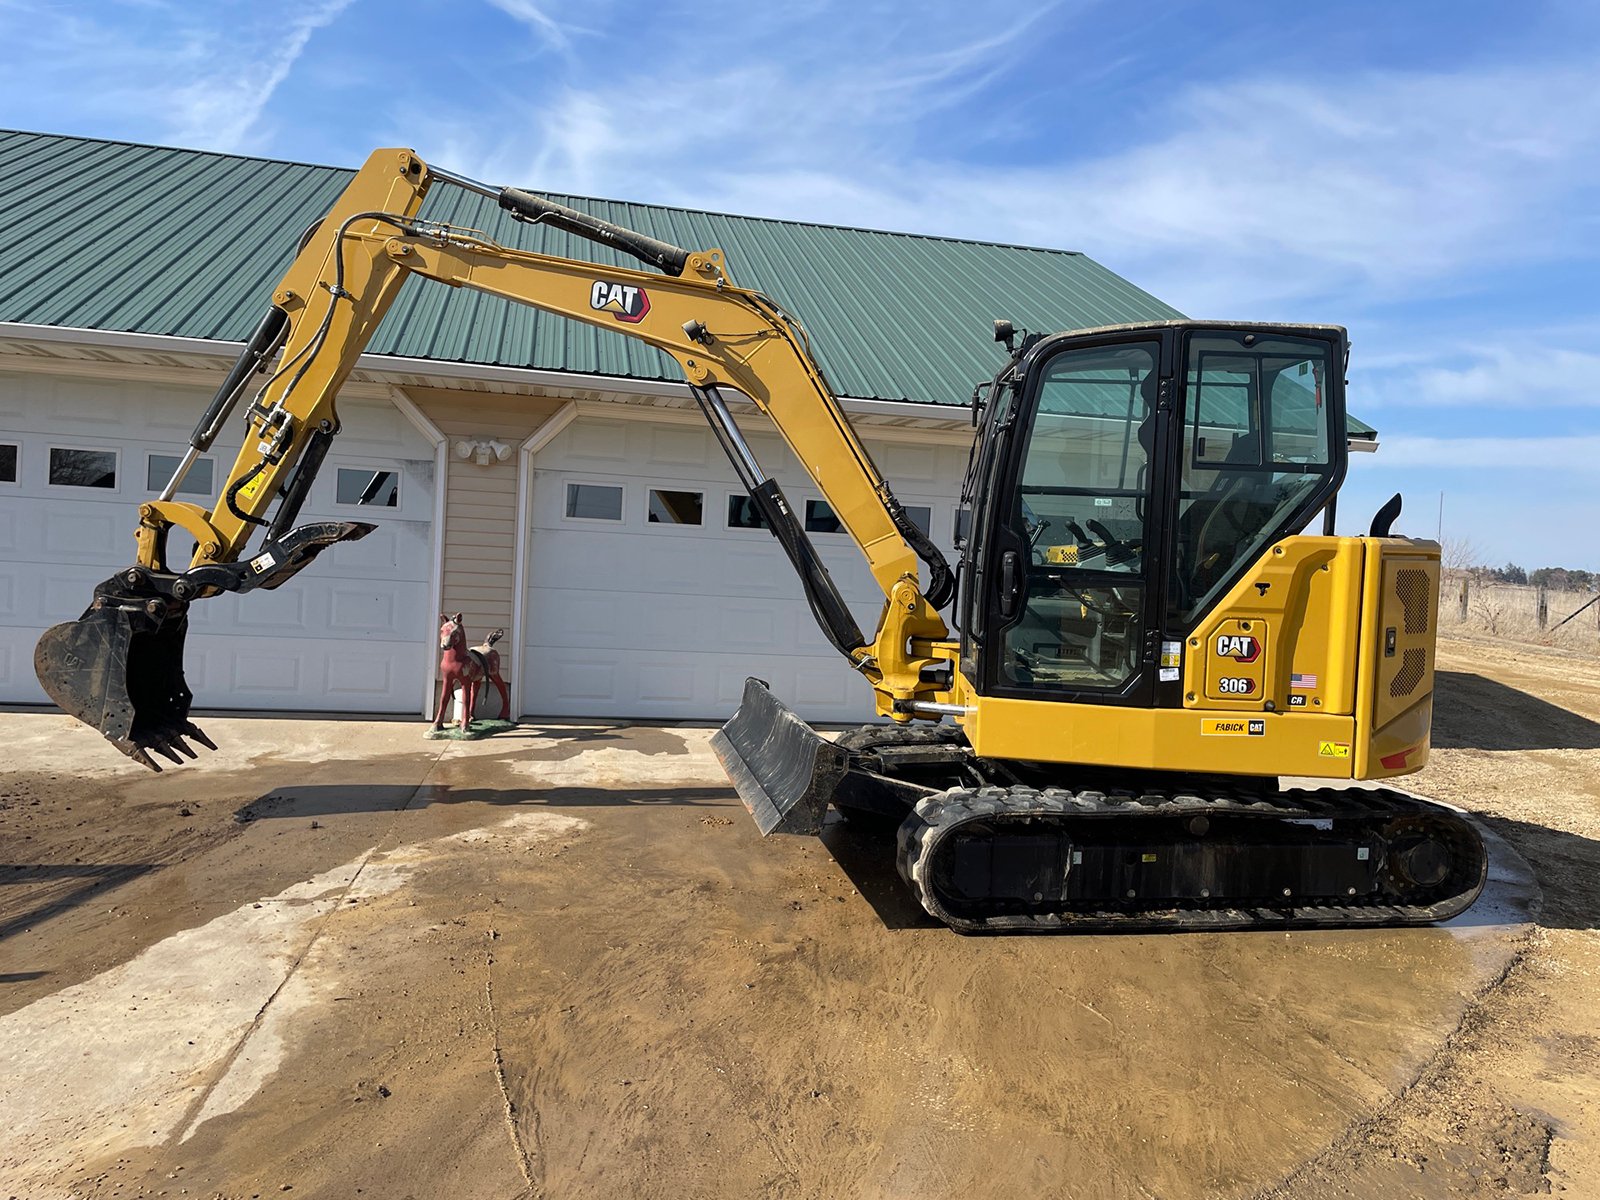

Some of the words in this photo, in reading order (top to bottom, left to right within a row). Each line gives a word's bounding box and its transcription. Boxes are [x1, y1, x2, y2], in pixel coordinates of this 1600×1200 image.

[592, 281, 638, 314] CAT
[1217, 636, 1251, 657] CAT
[1220, 678, 1247, 693] 306
[1291, 696, 1303, 704] CR
[1215, 723, 1245, 731] FABICK
[1249, 723, 1263, 732] CAT
